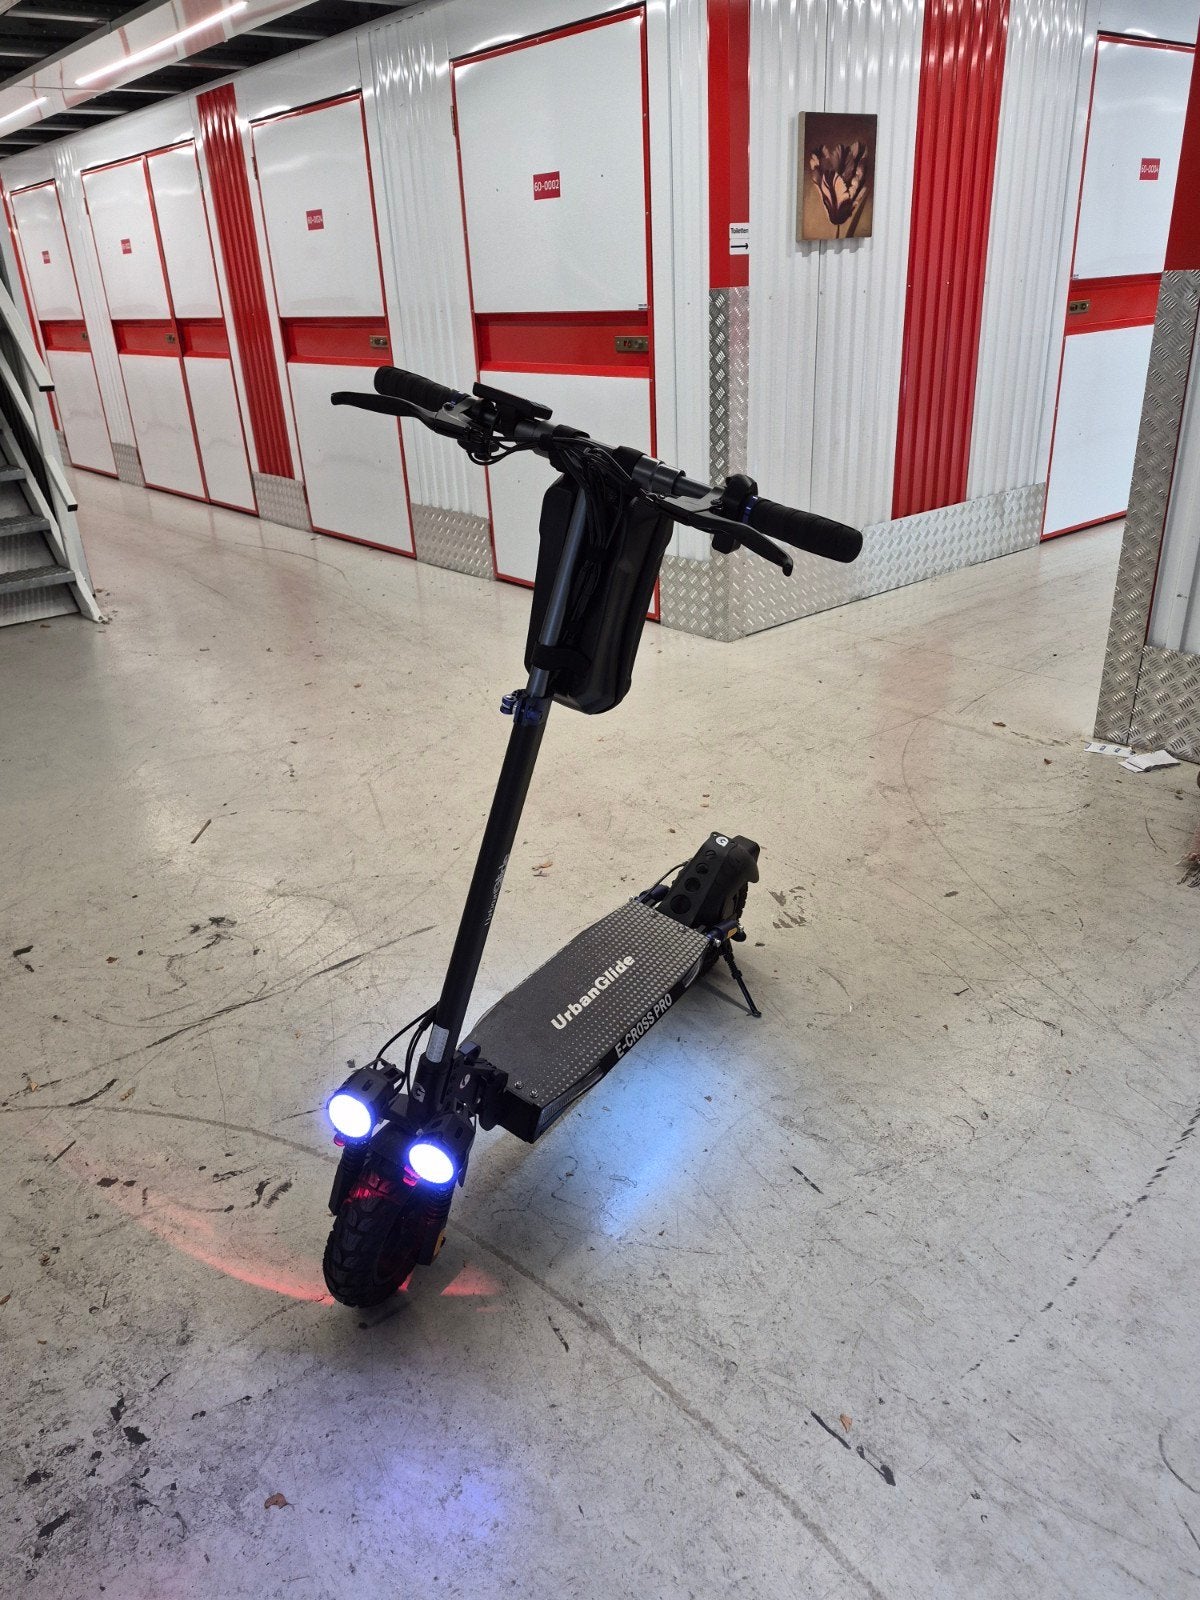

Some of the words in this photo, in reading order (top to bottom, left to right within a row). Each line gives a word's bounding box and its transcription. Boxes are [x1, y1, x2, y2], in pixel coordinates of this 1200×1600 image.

[550, 955, 635, 1030] UrbanGlide
[614, 1011, 655, 1059] E-CROSS
[653, 993, 673, 1018] PRO
